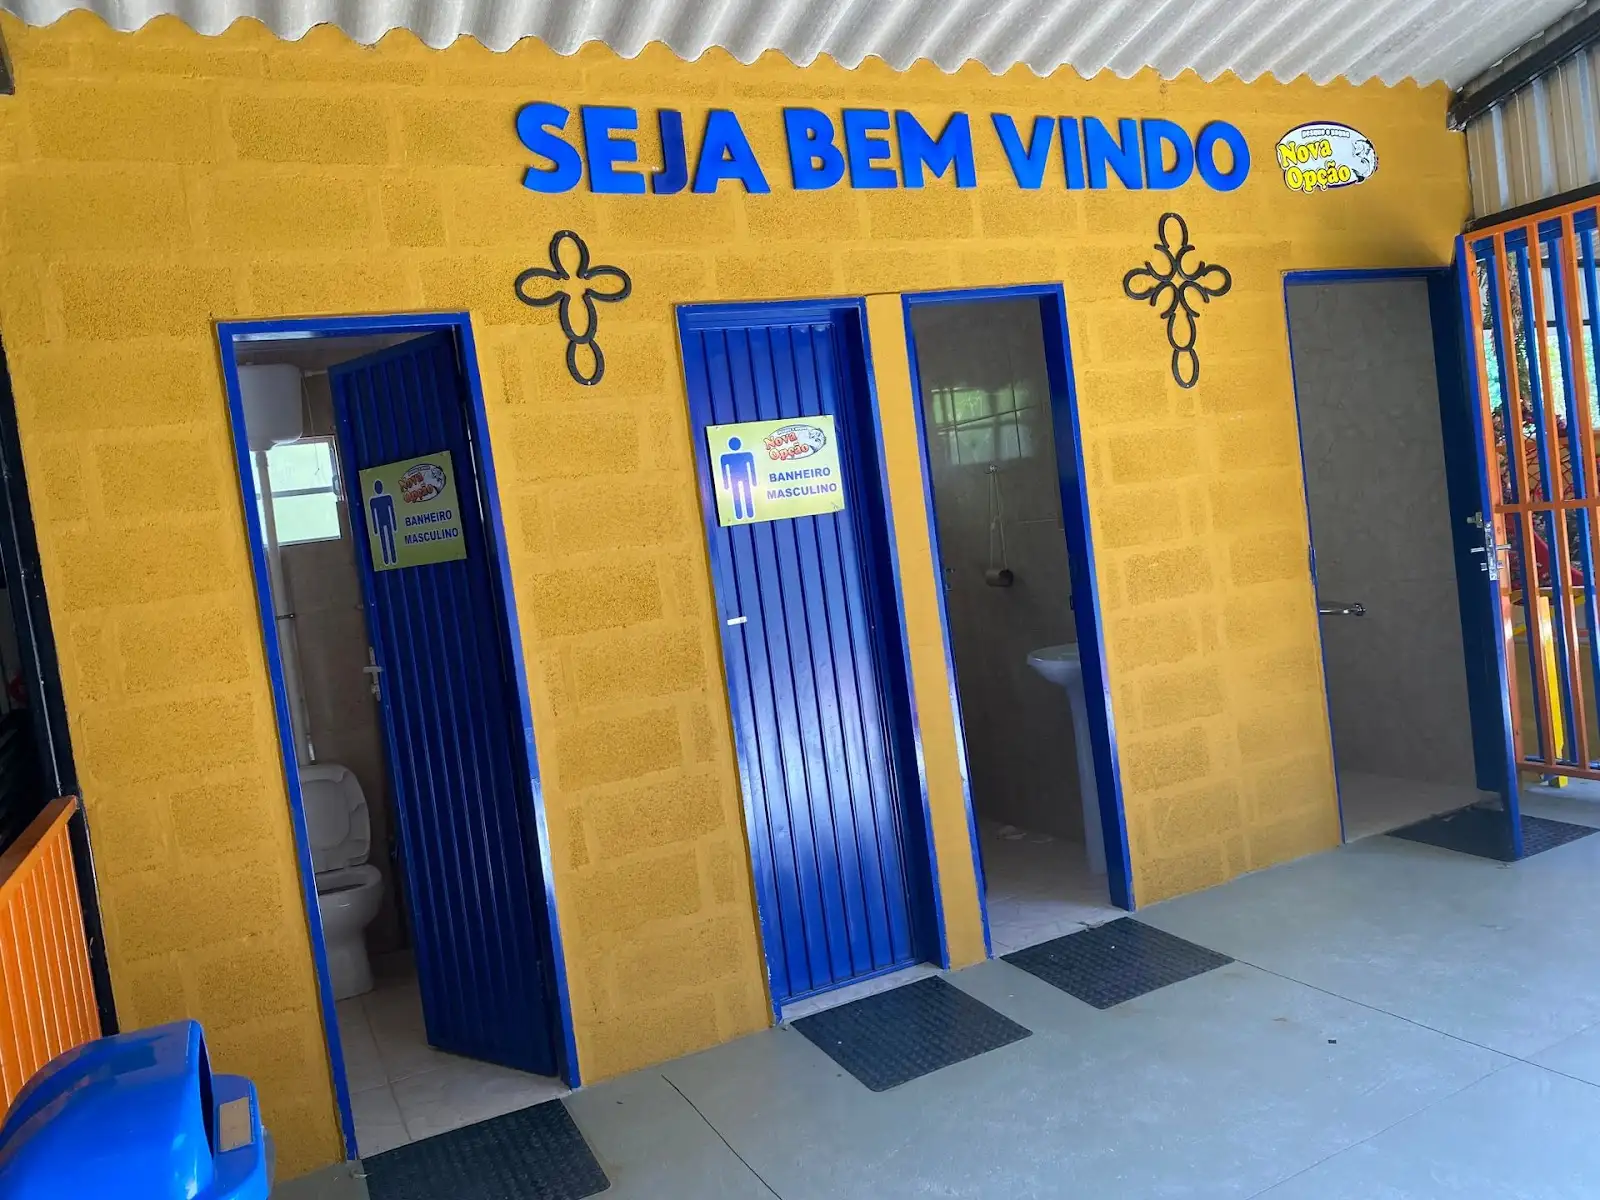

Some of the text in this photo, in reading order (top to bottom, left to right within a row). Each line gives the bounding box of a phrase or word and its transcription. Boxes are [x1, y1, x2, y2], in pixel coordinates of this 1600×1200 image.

[516, 101, 1251, 195] SEJA BEM VINDO
[1279, 139, 1333, 168] Nova
[1286, 160, 1351, 192] Opção
[763, 432, 797, 450] Nova
[769, 442, 809, 460] Opção
[769, 467, 831, 482] BANHEIRO
[767, 483, 837, 499] MASCULINO
[405, 509, 452, 527] BANHEIRO
[404, 527, 458, 544] MASCULINO
